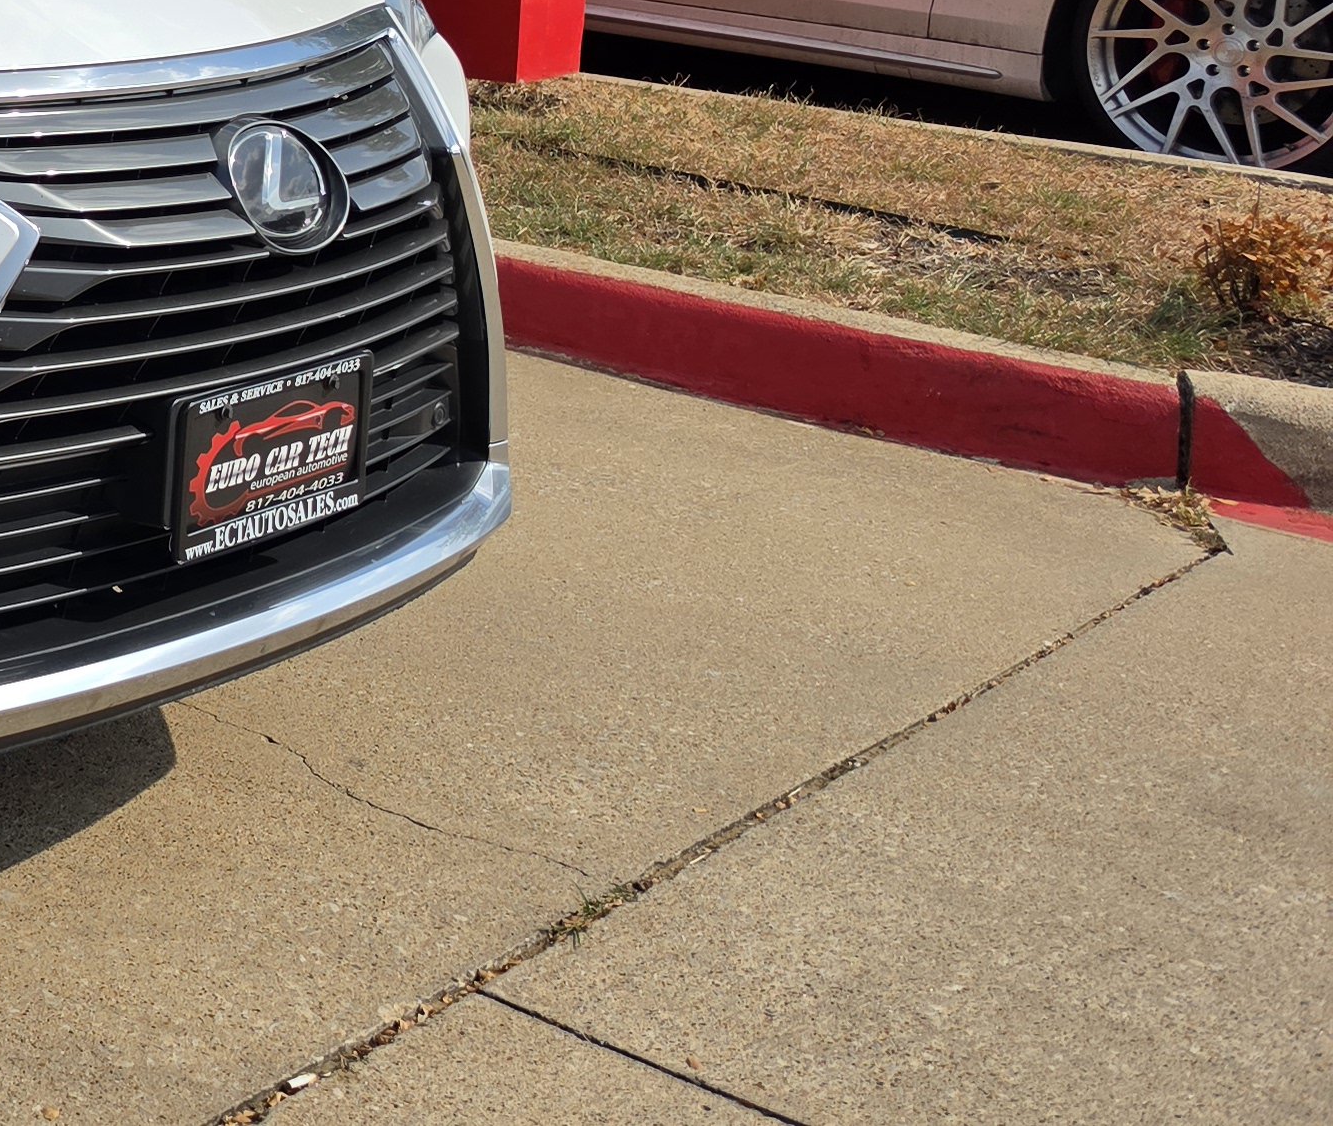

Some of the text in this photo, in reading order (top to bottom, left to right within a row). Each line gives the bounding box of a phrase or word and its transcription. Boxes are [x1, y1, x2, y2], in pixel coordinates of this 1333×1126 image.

[199, 358, 361, 414] SALES & SERVICE 817-404-4033
[206, 425, 353, 493] EURO CAR TECH
[250, 452, 348, 491] european automotive
[245, 472, 344, 513] 817-404-4033
[185, 491, 359, 561] www.ECTAUTOSALES.com
